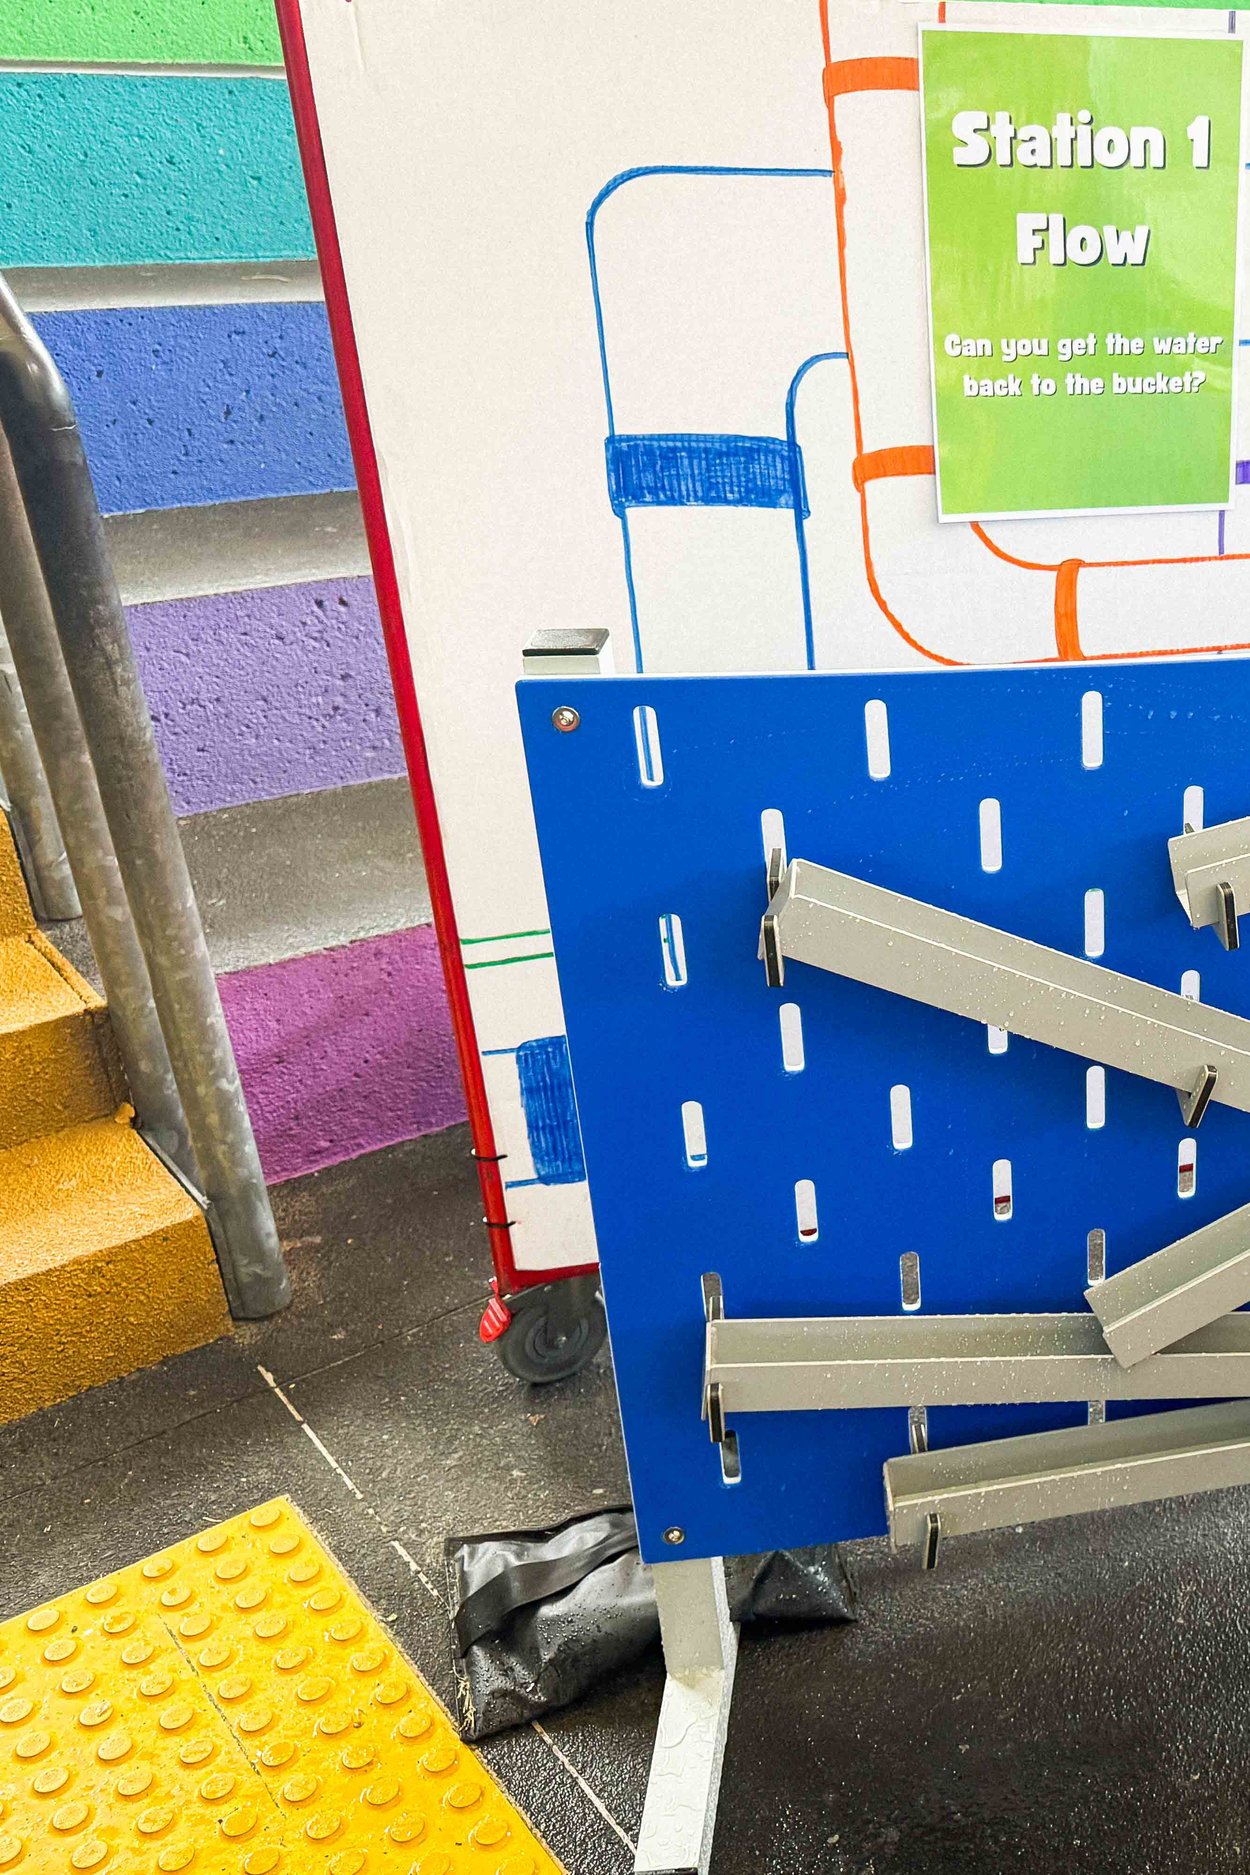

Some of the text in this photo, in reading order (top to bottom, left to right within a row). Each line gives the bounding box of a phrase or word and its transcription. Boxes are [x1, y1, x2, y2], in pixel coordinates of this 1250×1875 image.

[951, 109, 1211, 170] Station 1
[1016, 212, 1150, 267] Flow
[944, 331, 1223, 362] Can you get the water
[963, 371, 1206, 398] back to the bucket?
